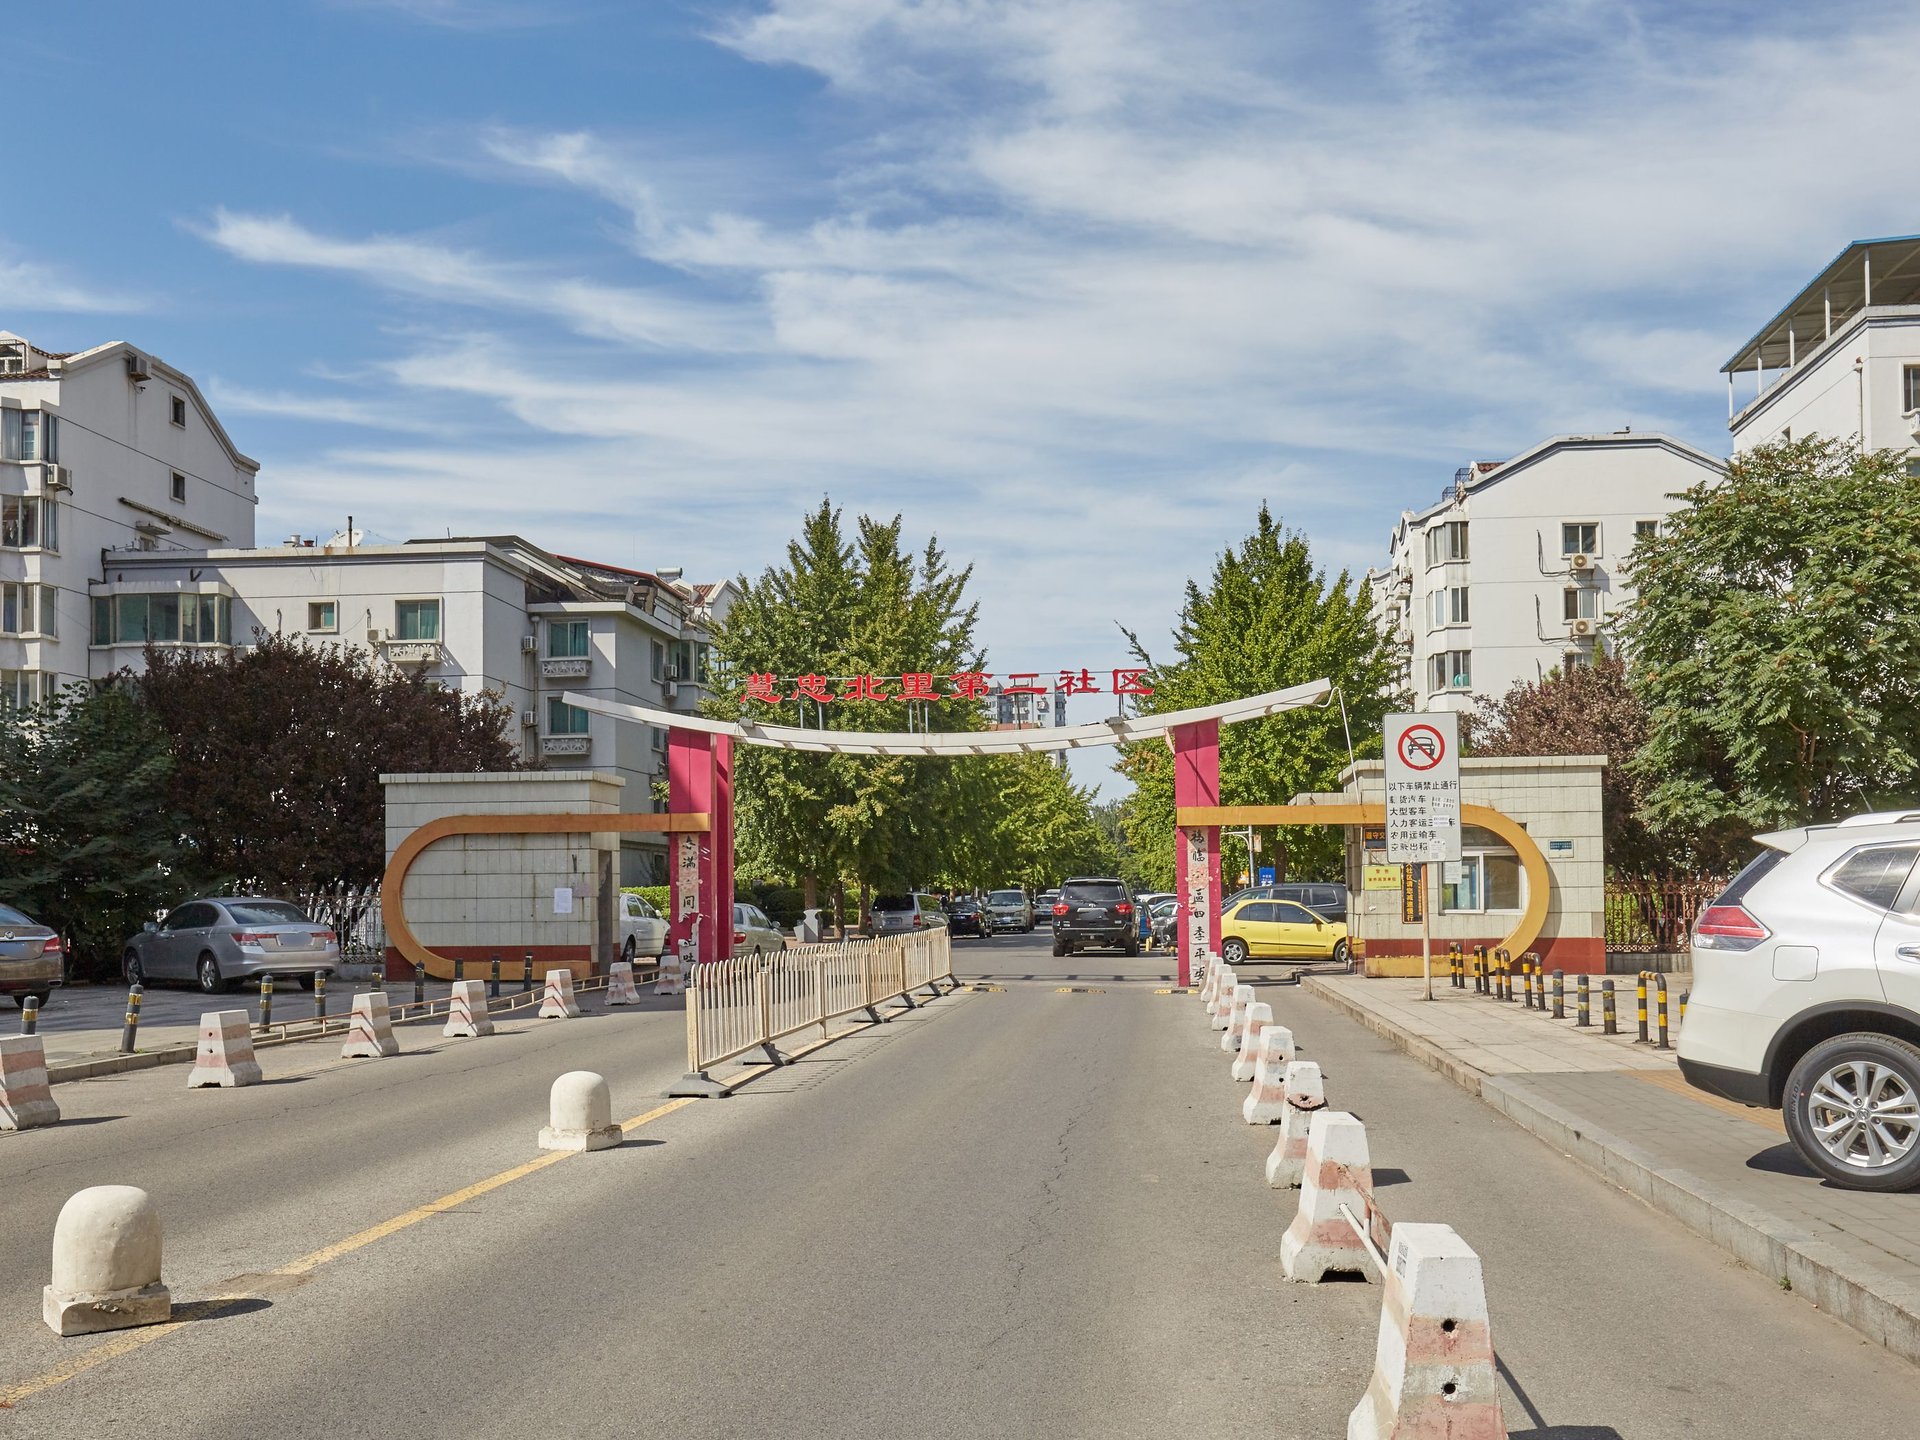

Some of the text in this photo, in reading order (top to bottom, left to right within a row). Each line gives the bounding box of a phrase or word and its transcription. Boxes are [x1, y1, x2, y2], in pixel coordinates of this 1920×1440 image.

[740, 668, 1155, 703] 慧忠北里第二社区
[1388, 780, 1457, 791] 以下车辆禁止通行
[1389, 807, 1427, 816] 大型客车
[1390, 818, 1456, 828] 人力客运三车
[1390, 830, 1437, 840] 农用运输车
